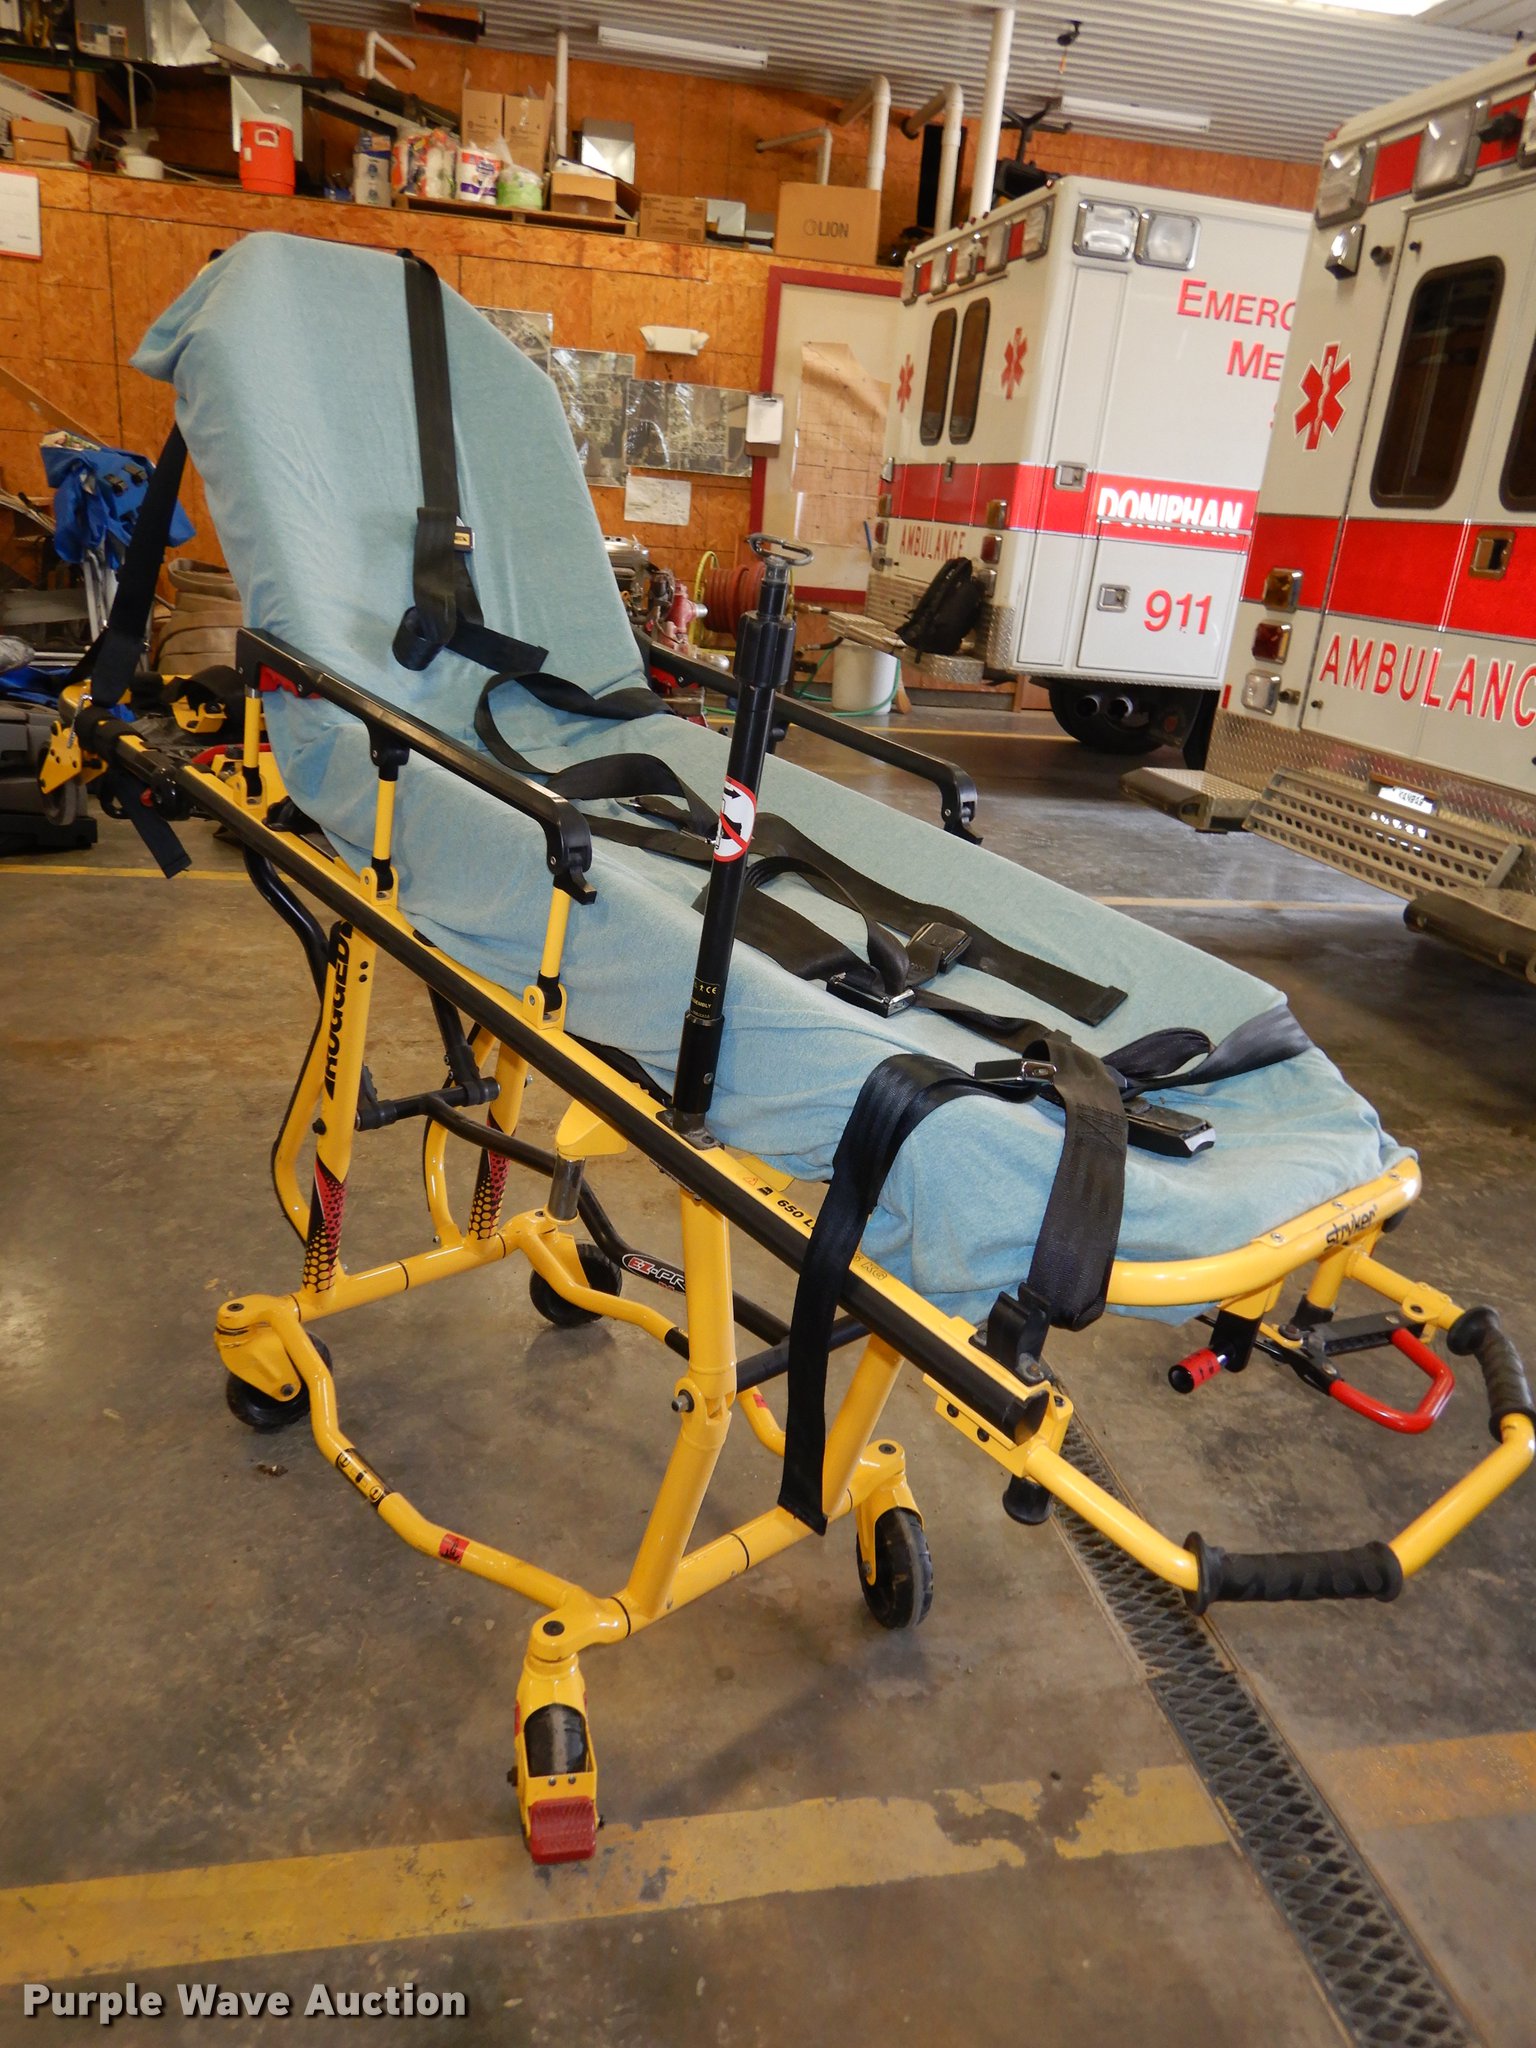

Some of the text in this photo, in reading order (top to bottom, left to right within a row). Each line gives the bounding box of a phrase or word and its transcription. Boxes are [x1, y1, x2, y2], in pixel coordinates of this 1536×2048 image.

[818, 220, 849, 238] LION
[1096, 487, 1243, 537] DONIPHAN
[899, 525, 966, 561] AMBULANCE
[1144, 589, 1212, 635] 911
[777, 1199, 804, 1218] 650
